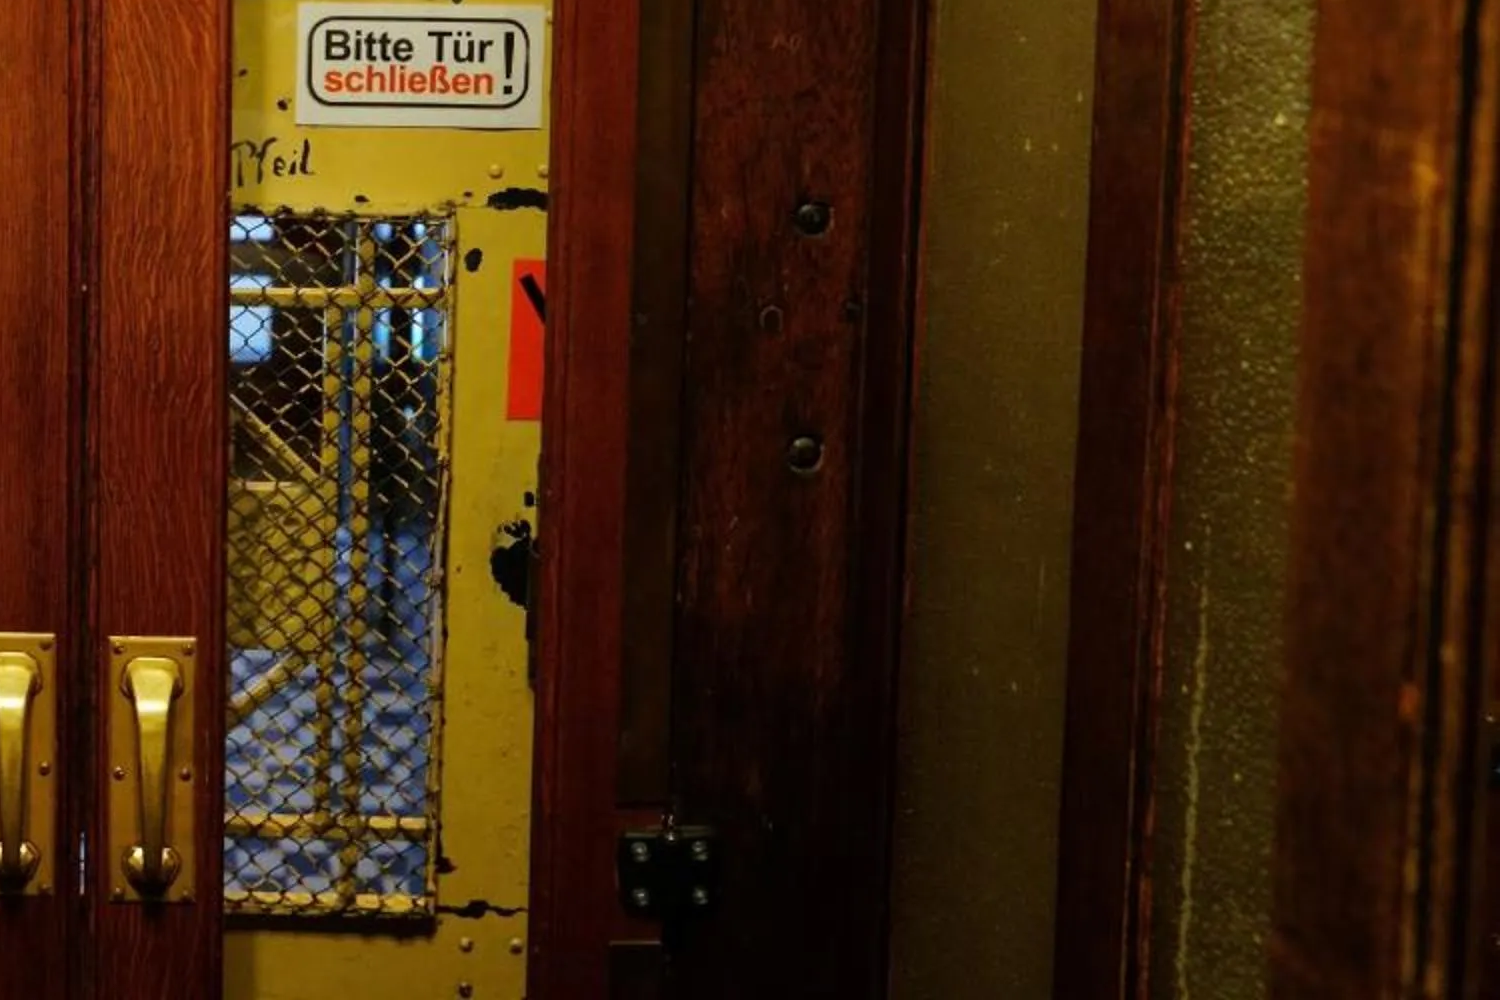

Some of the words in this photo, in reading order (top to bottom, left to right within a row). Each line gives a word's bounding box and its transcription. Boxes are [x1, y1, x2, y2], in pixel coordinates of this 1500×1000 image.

[324, 29, 414, 62] Bitte
[427, 30, 494, 63] Tür
[323, 64, 494, 96] schließen
[231, 136, 315, 188] Pfeil
